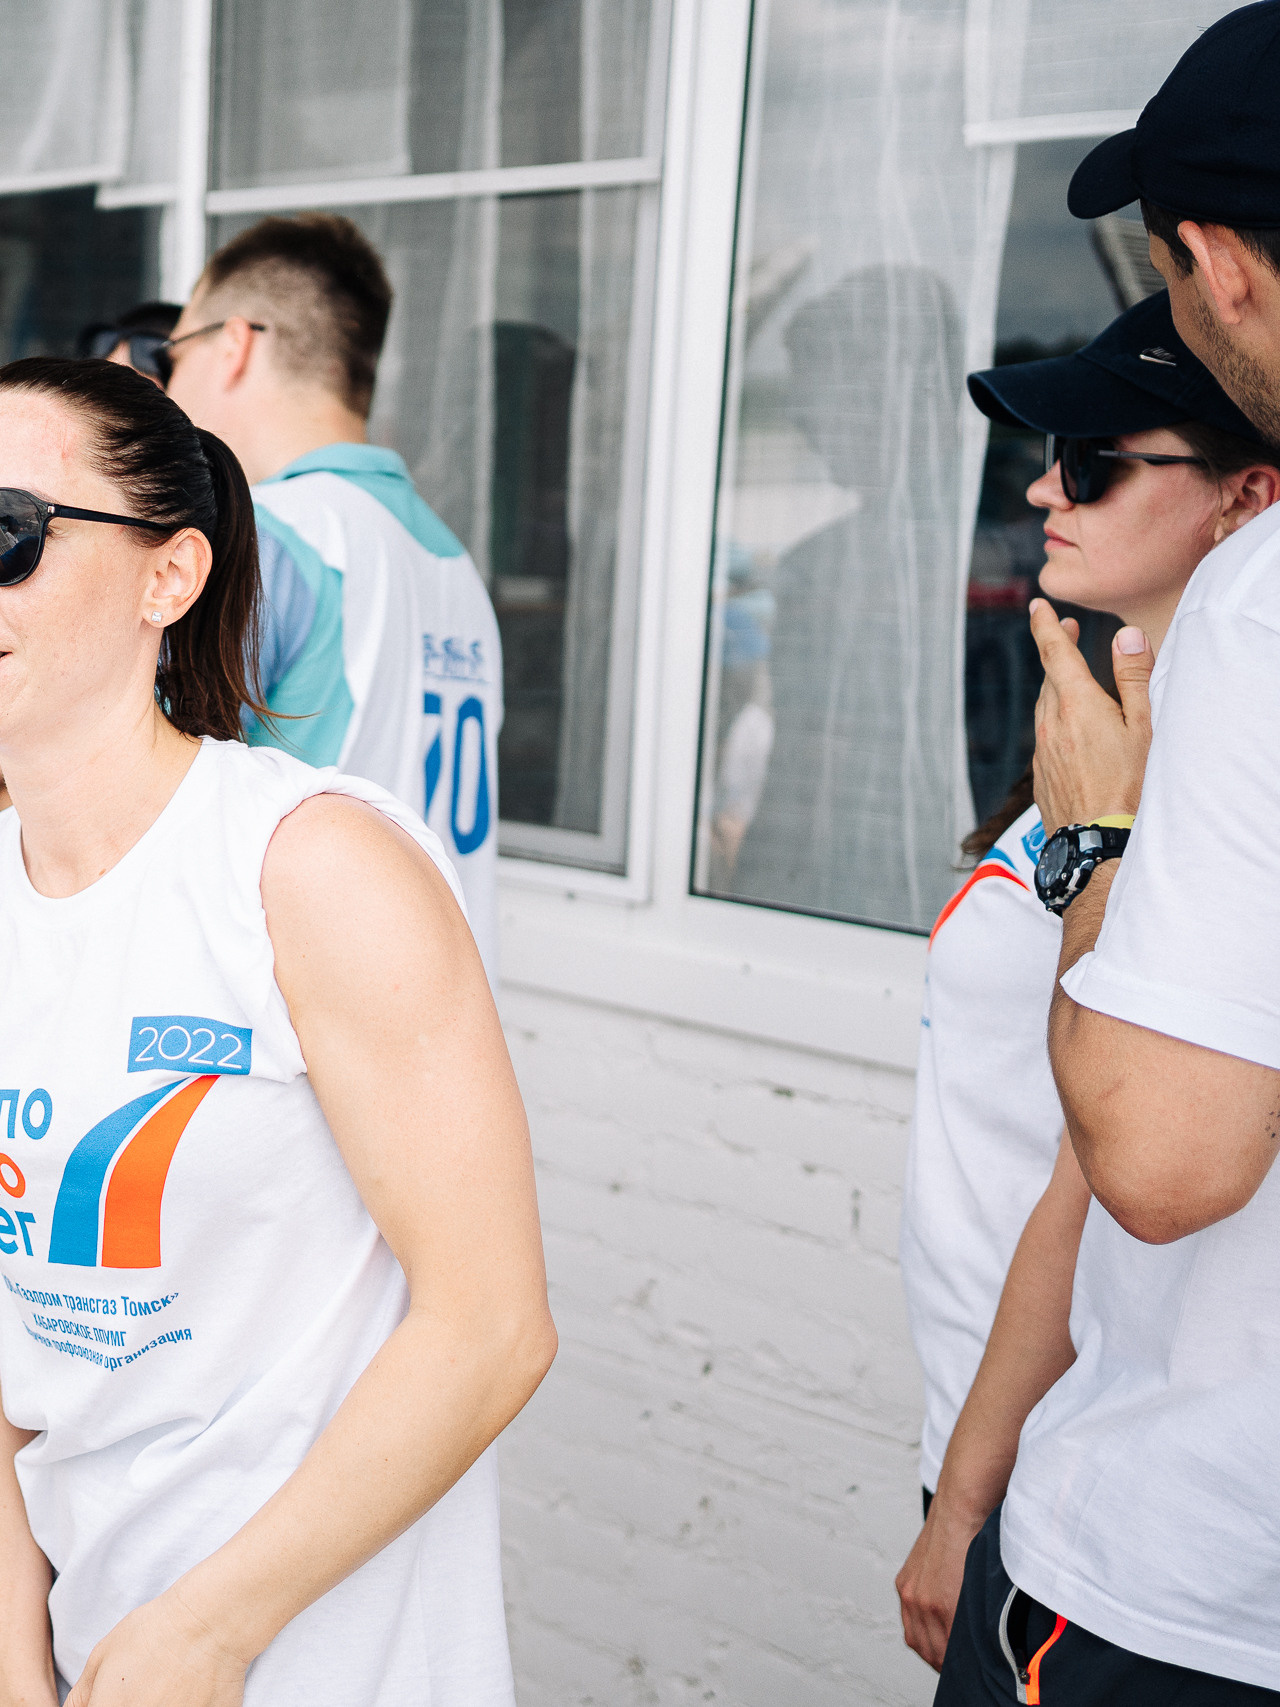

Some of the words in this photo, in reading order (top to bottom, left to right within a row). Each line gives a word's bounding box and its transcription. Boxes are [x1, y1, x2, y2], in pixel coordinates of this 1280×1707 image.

[134, 1025, 243, 1069] 2022
[63, 1294, 117, 1315] трансгаз
[121, 1292, 179, 1316] Томск»
[104, 1329, 192, 1371] организация
